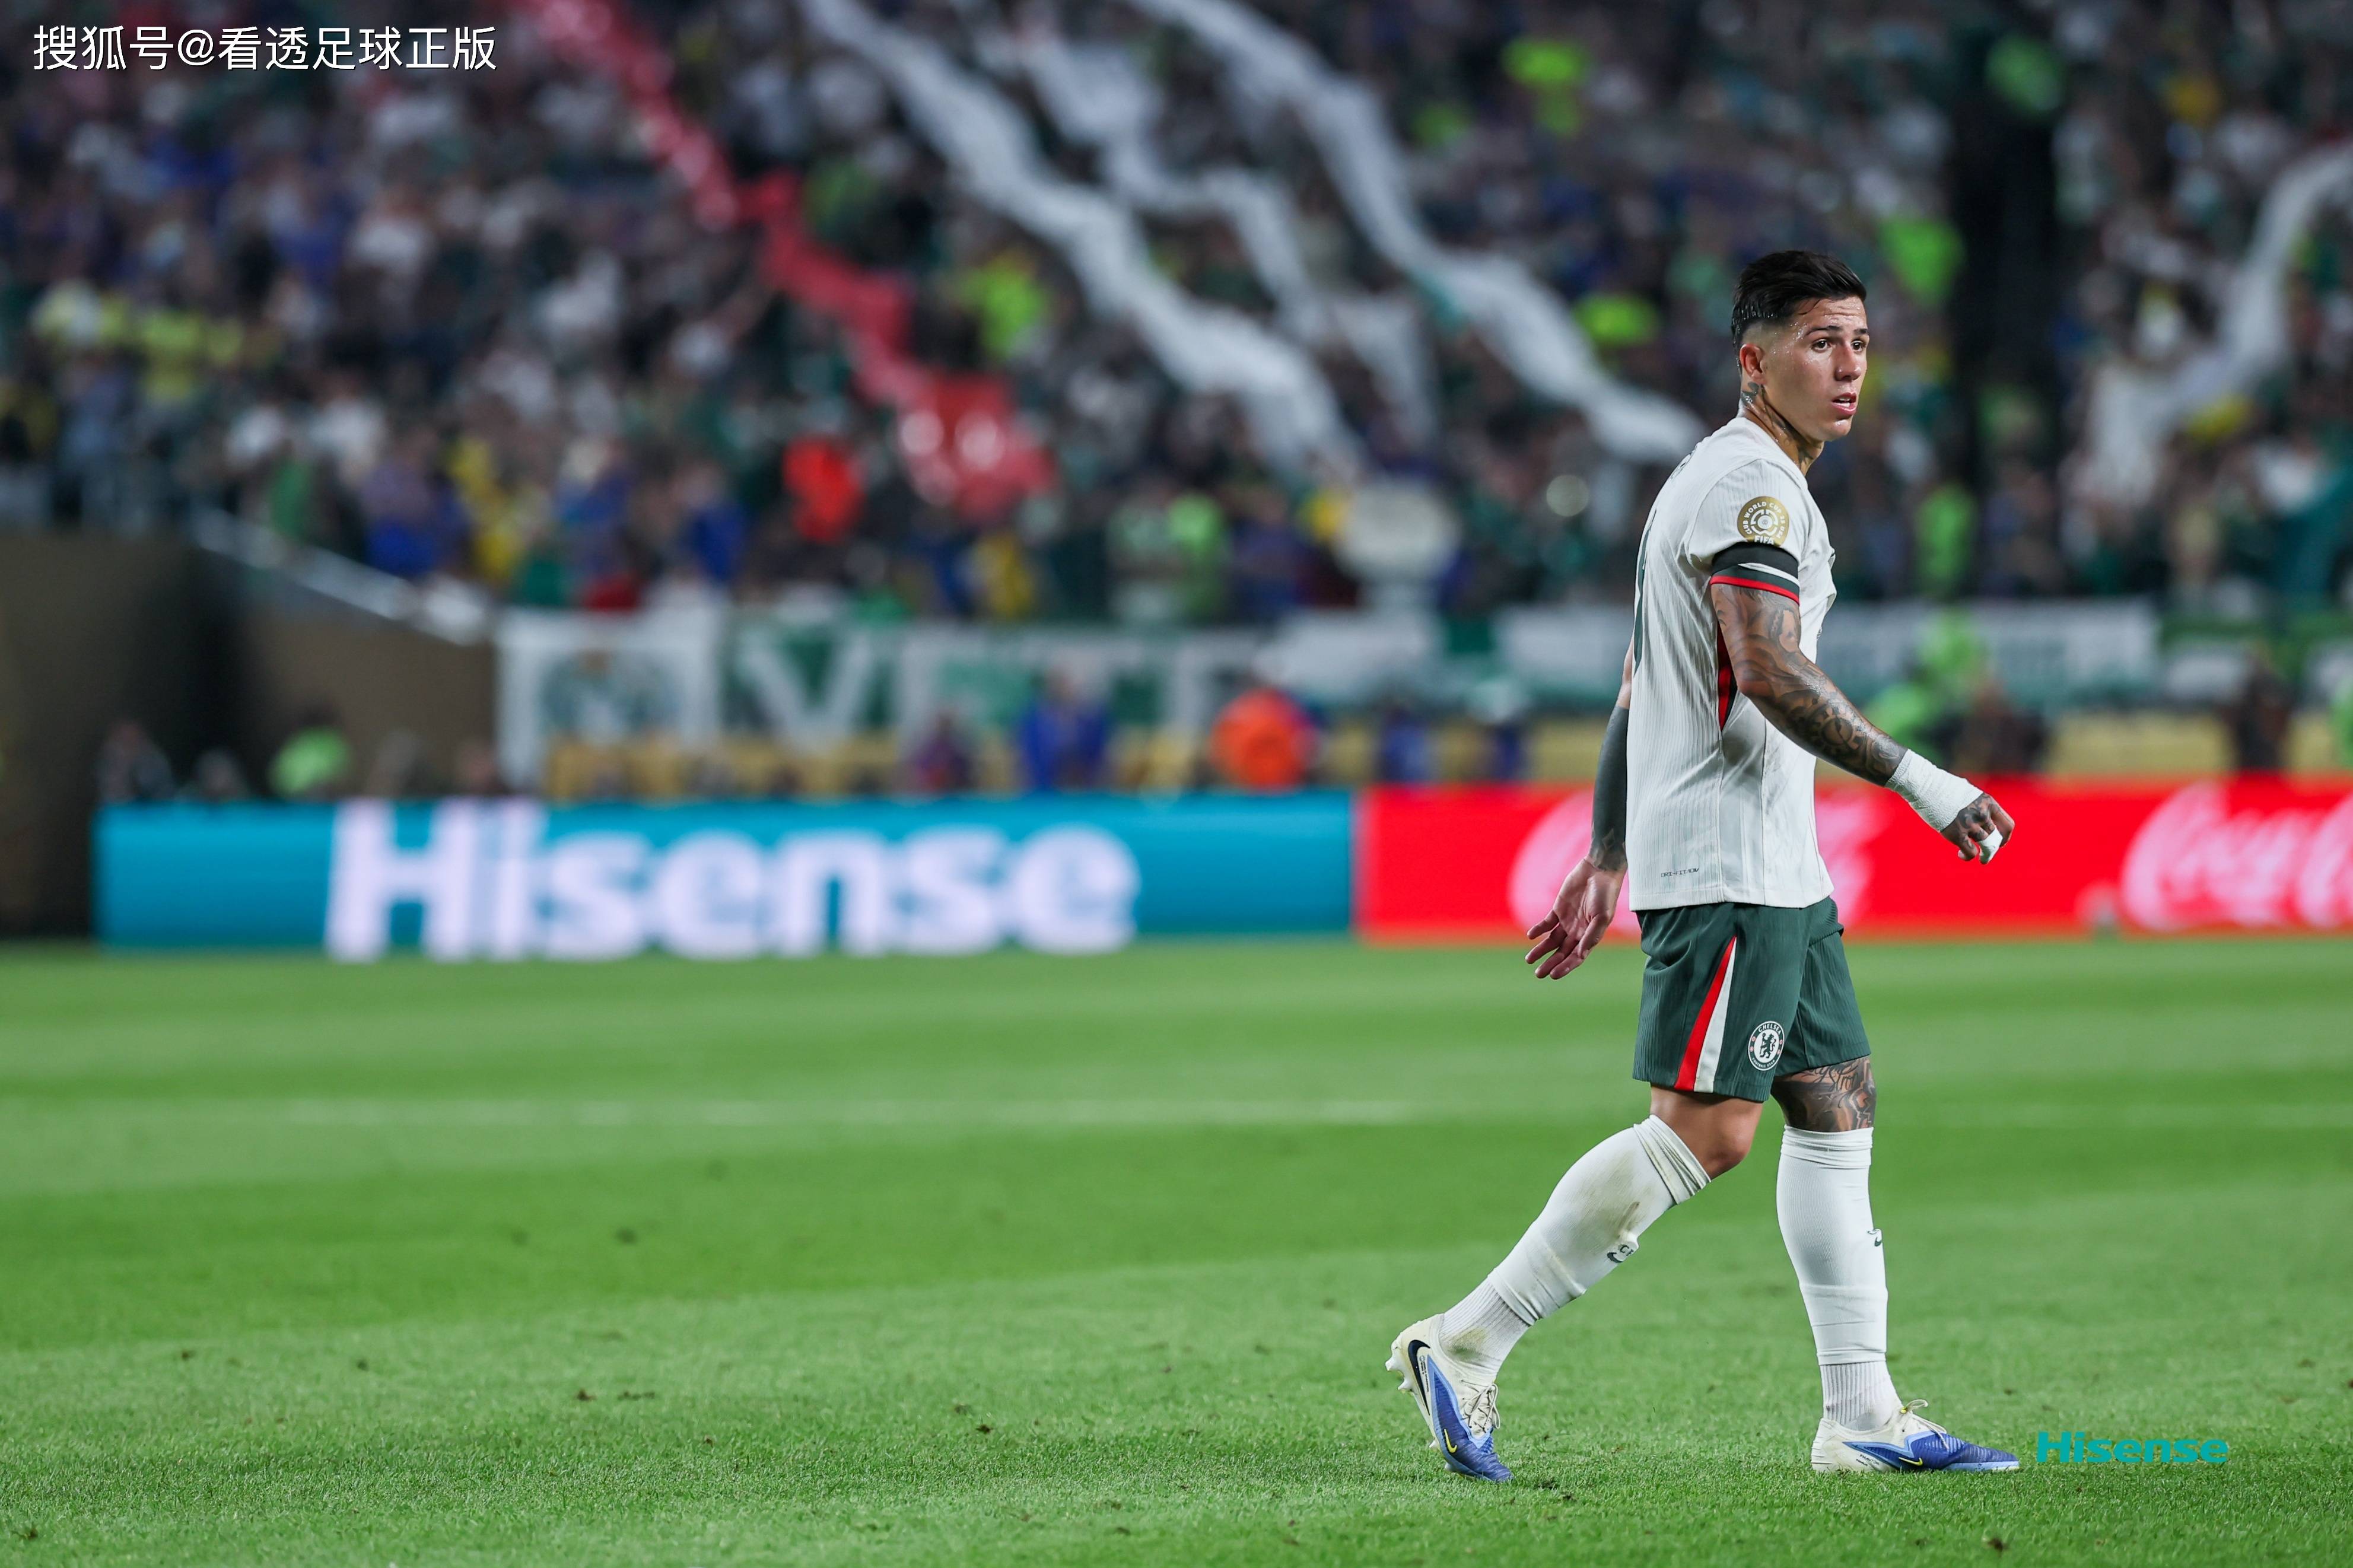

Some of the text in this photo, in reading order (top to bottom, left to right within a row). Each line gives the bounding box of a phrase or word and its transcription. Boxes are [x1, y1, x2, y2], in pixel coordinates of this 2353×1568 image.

[1744, 501, 1767, 518] WORLD
[1769, 502, 1782, 513] CUP
[1743, 520, 1753, 535] CLUB
[1776, 526, 1785, 539] USA
[1754, 535, 1775, 545] FIFA
[326, 800, 1140, 961] Hisense
[1758, 1023, 1782, 1035] CHELSEA
